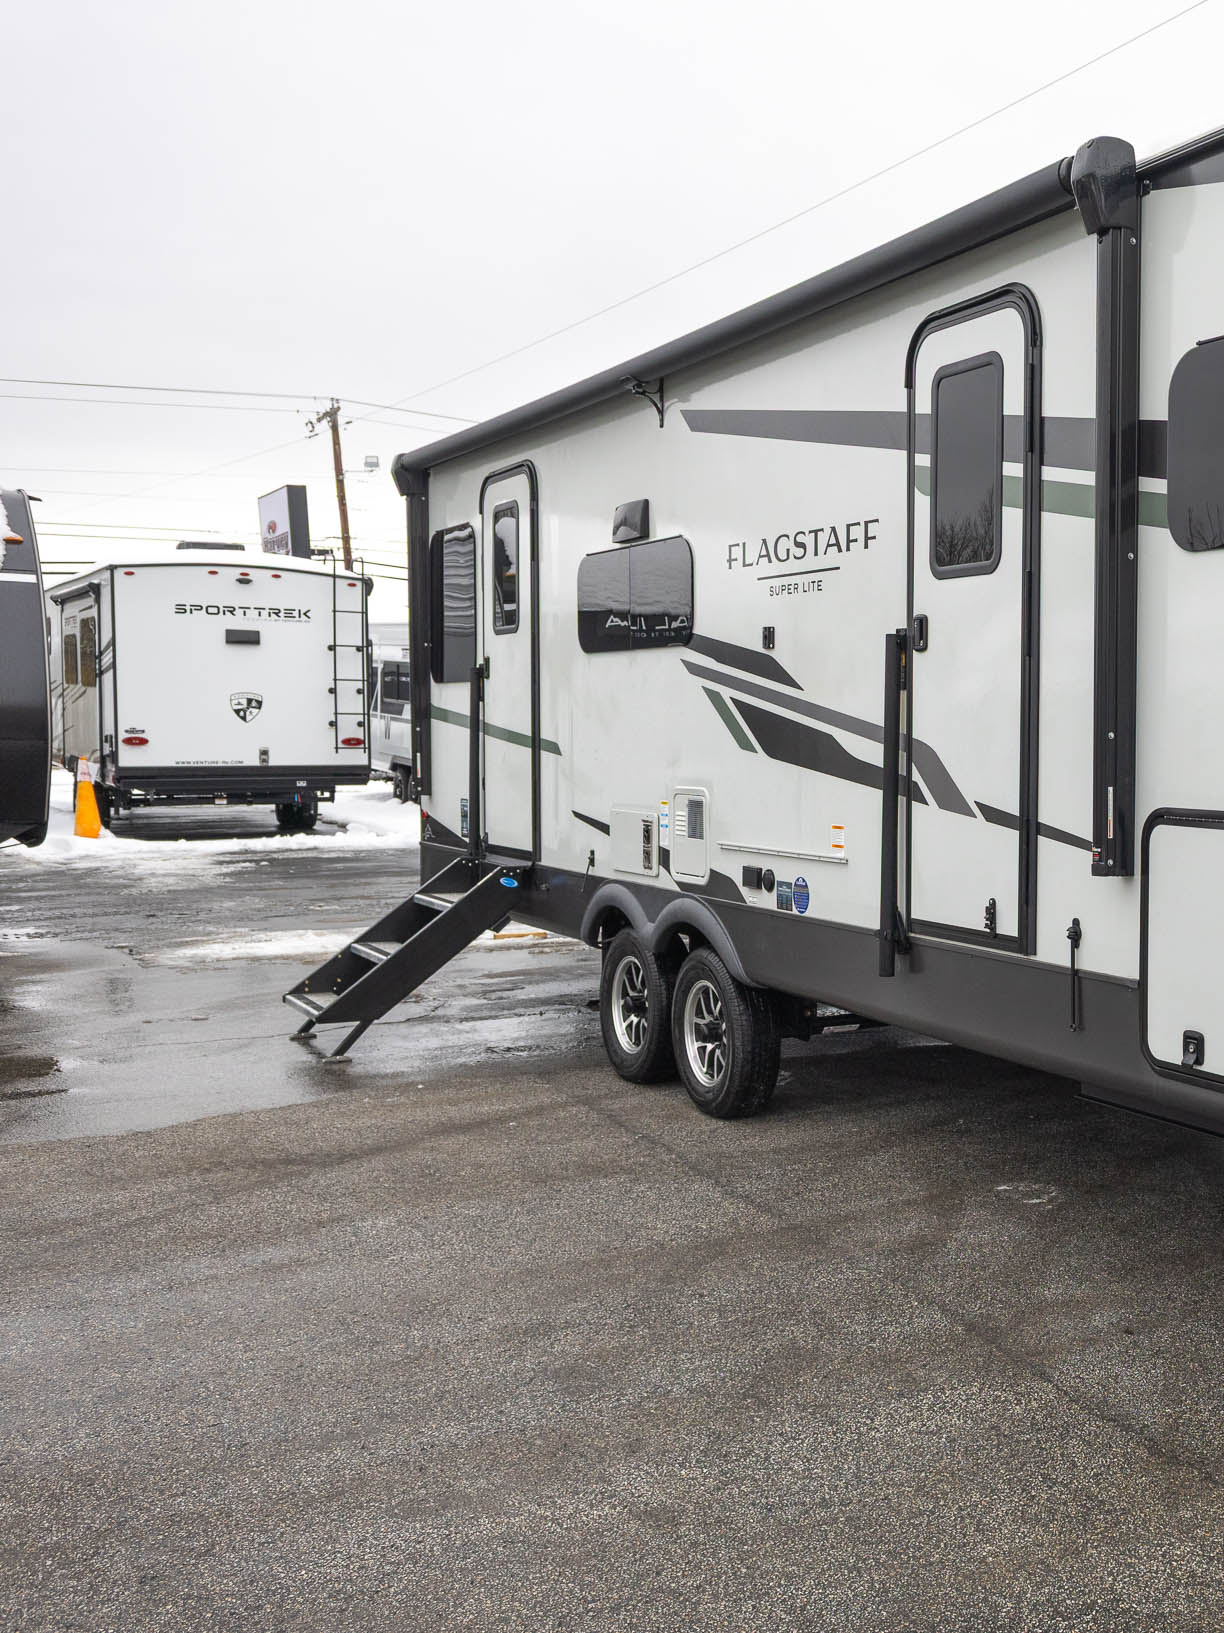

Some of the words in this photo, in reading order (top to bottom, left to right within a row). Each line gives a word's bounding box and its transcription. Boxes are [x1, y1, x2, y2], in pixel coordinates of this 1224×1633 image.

[726, 518, 880, 570] FLAGSTAFF
[769, 583, 799, 597] SUPER
[802, 579, 823, 593] LITE
[174, 603, 311, 620] SPORTTREK
